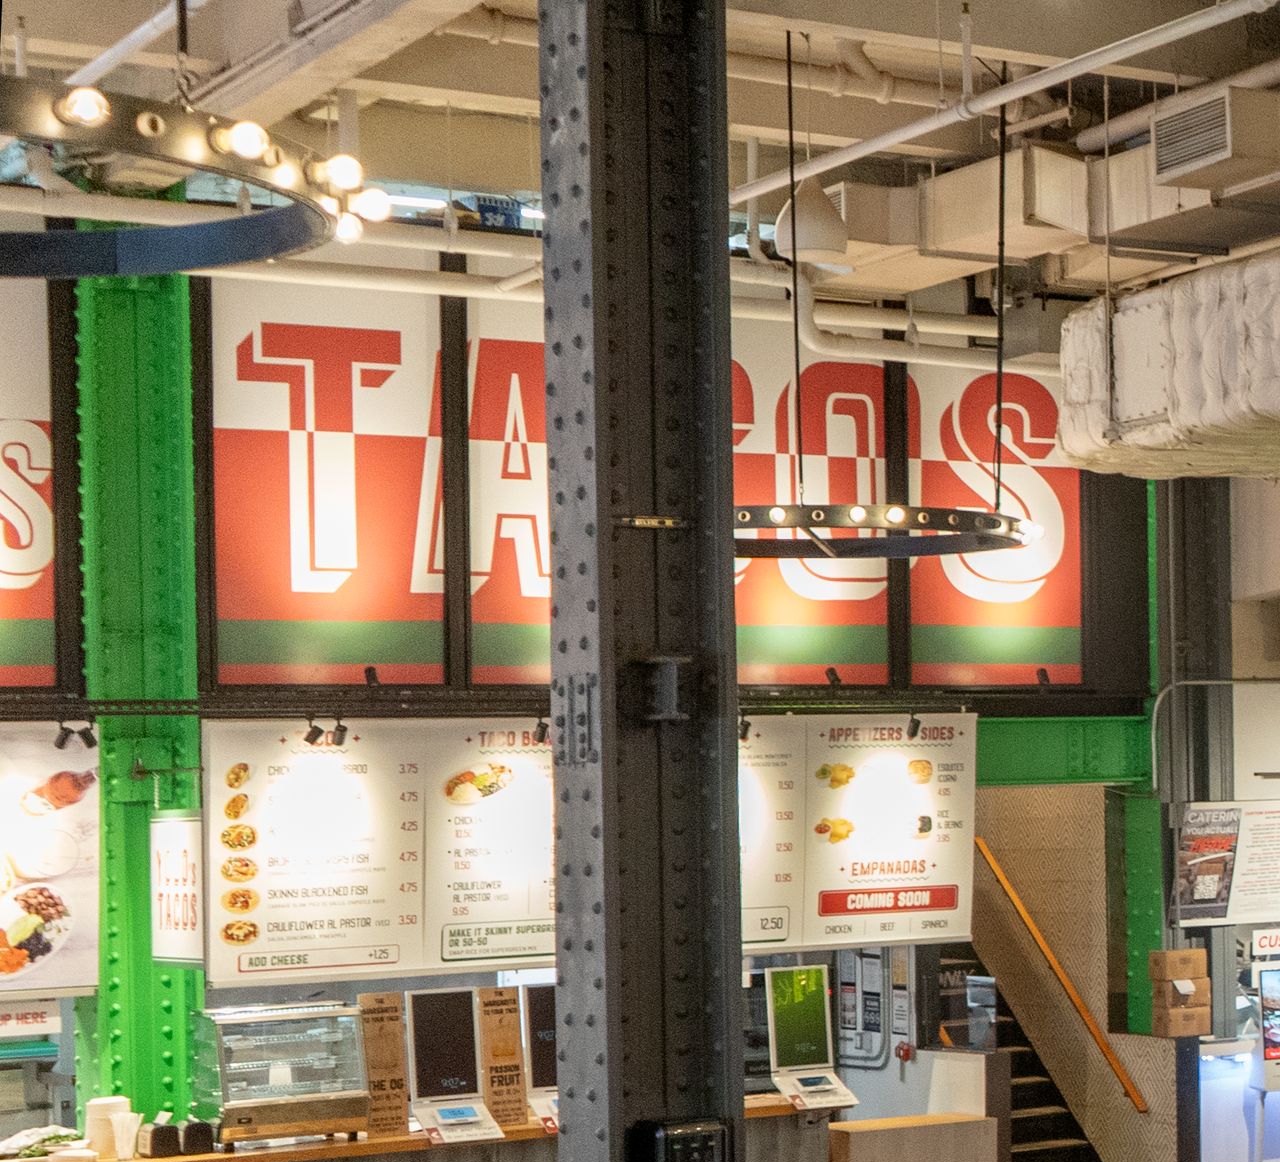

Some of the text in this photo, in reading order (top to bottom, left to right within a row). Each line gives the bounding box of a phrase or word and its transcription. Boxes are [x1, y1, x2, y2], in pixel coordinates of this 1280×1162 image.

[237, 321, 1064, 603] TAOS
[479, 731, 516, 748] TACO
[921, 726, 955, 741] SIDES
[399, 763, 418, 774] 3.75
[778, 781, 794, 790] 11.50
[400, 792, 418, 802] 4.75
[776, 811, 793, 821] 13.50
[1188, 810, 1238, 823] CATERIN
[401, 821, 418, 832] 4.25
[776, 843, 793, 852] 12.50
[400, 852, 418, 862] 4.75
[851, 860, 927, 876] EMPANADAS
[268, 882, 418, 900] SKINNY BLACKENED FISH 4.75
[453, 880, 502, 891] CAULIFLOWER
[453, 892, 491, 902] AL PASTOR
[847, 890, 931, 909] COMING SOON
[157, 893, 197, 932] TACOS
[452, 907, 469, 916] 9.95
[267, 915, 417, 933] CAULIFLOWER AL PASTOR 3.50
[760, 917, 784, 930] 12.50
[825, 920, 948, 935] CHICKEN BEEF SPINACH
[449, 927, 512, 937] MAKE IT SKINNY
[449, 937, 488, 947] OR 50-50
[248, 949, 389, 968] ADD CHEESE +1.25
[16, 1011, 47, 1025] HERE
[489, 1064, 520, 1074] PASSION
[369, 1078, 404, 1091] THE OG
[490, 1073, 521, 1087] FRUIT
